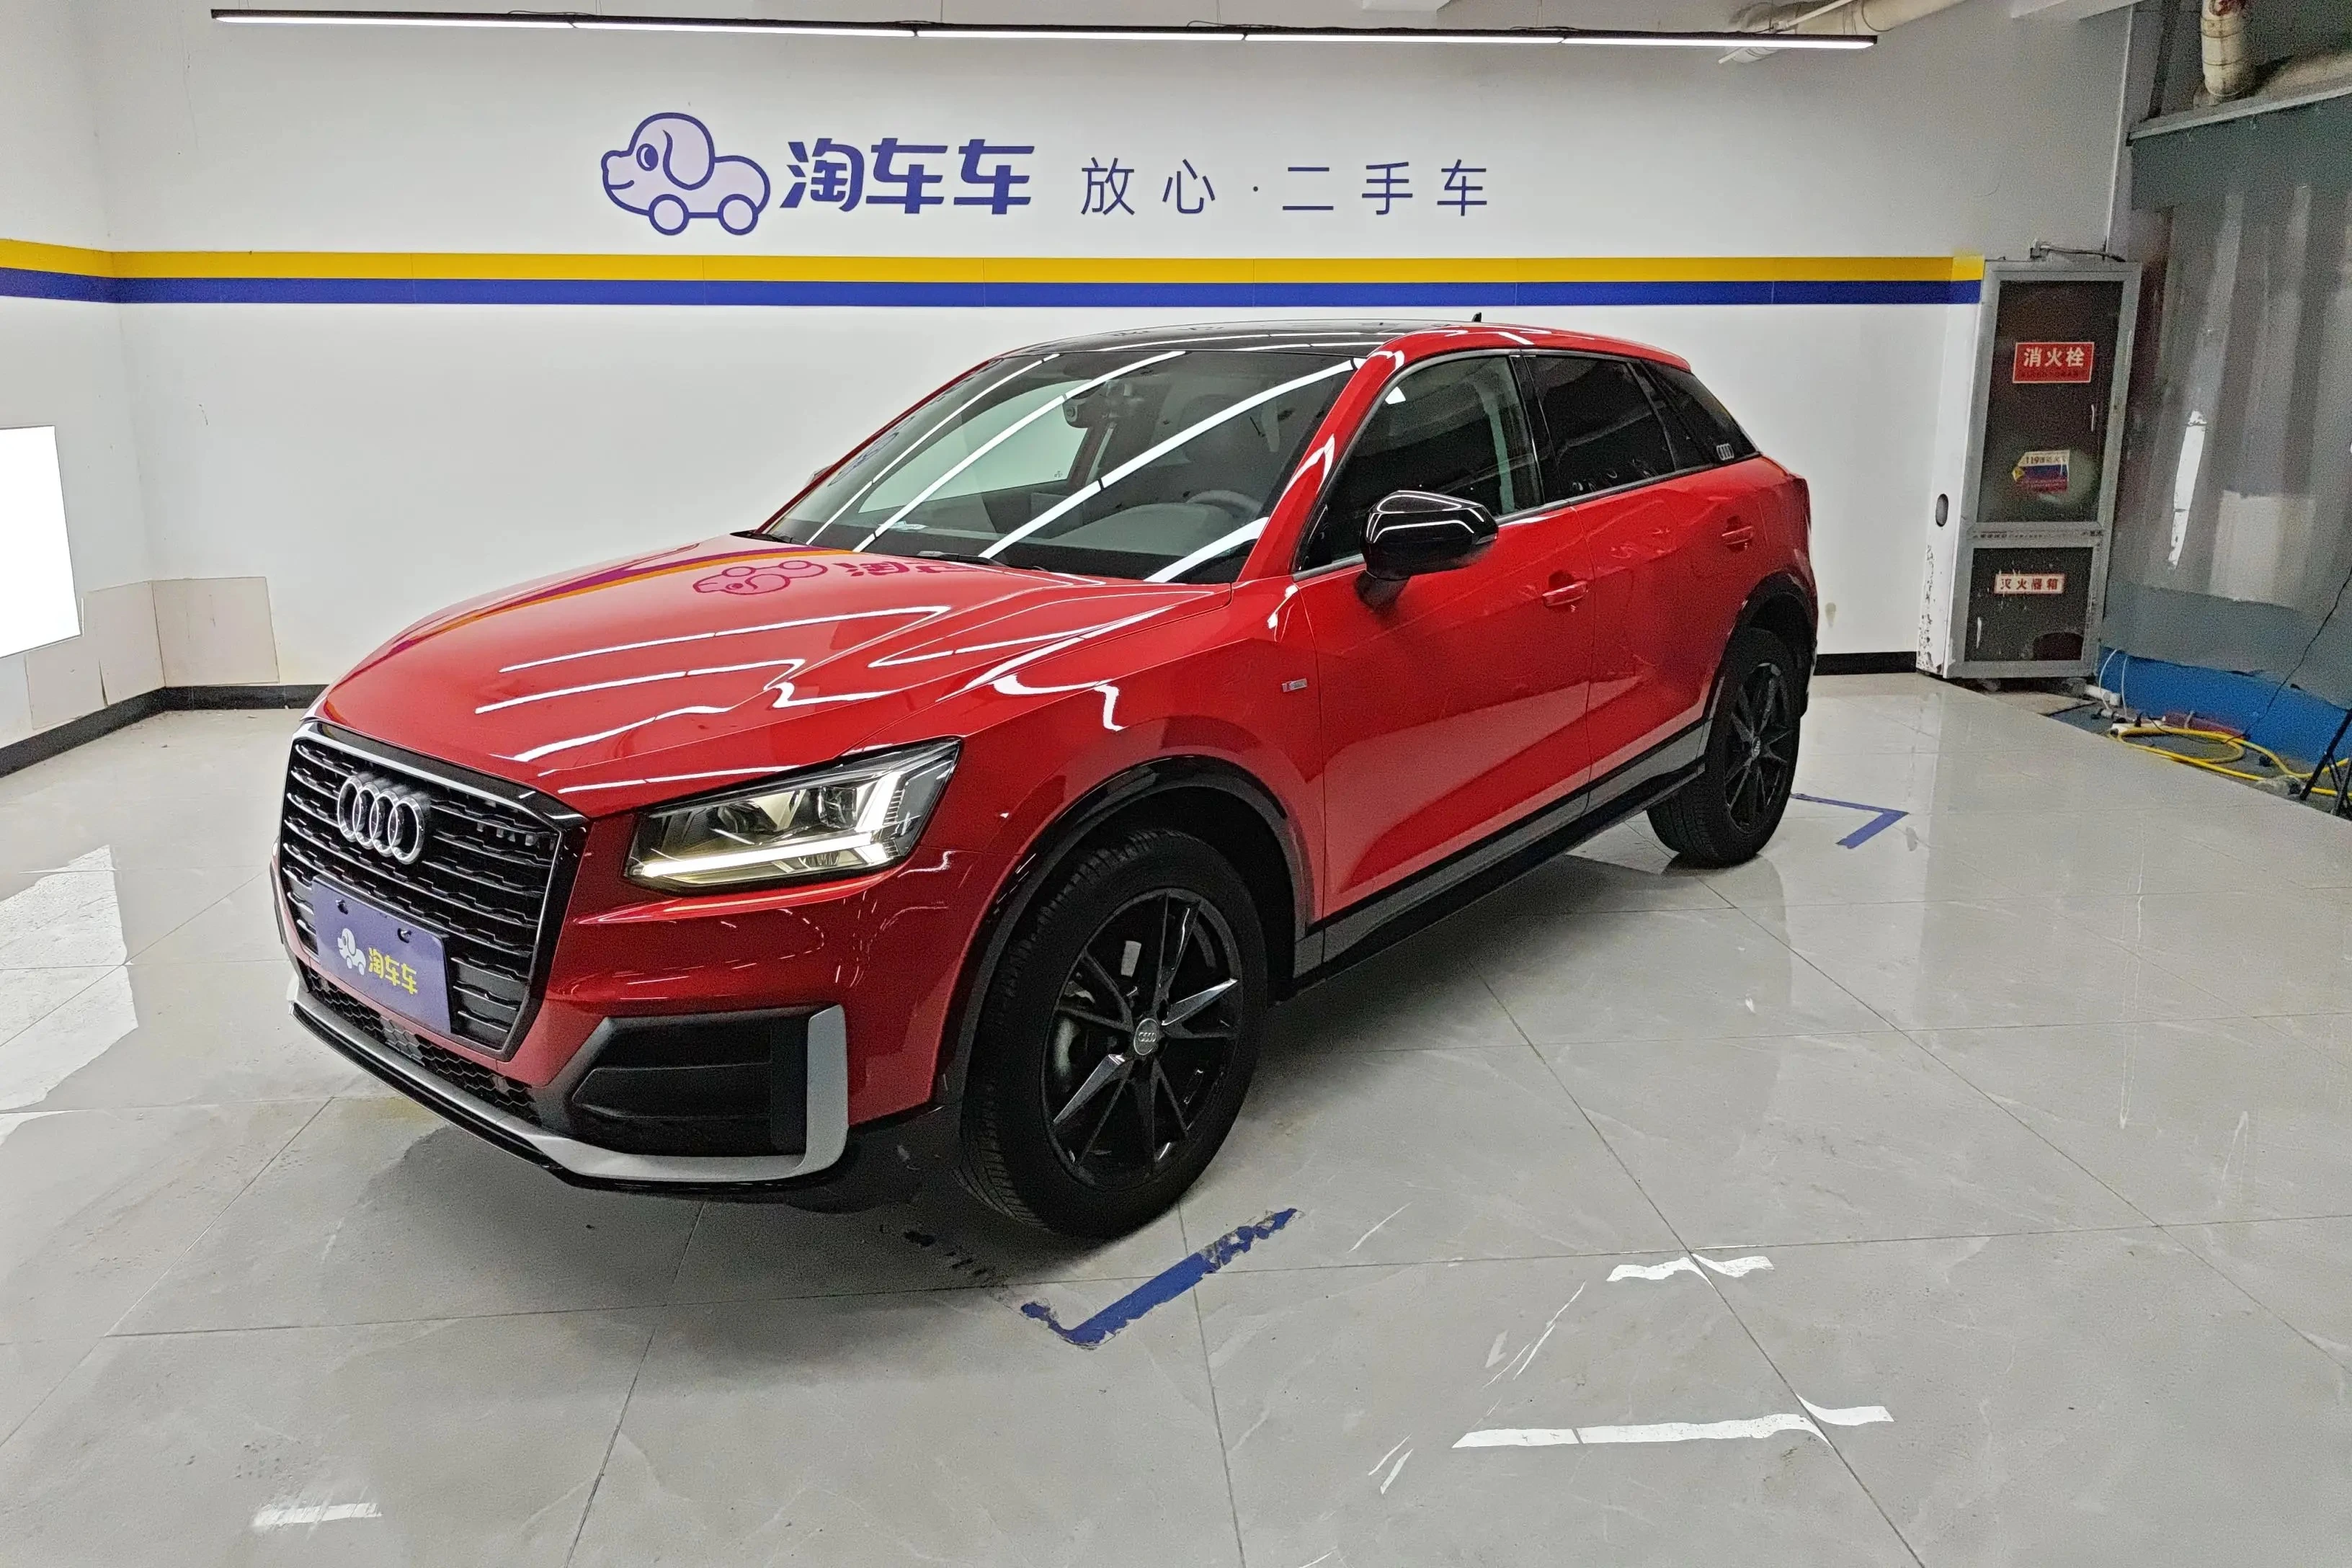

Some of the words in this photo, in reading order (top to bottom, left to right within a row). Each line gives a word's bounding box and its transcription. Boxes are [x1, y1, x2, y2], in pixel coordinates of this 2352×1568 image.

[780, 138, 1035, 215] 淘车车
[2023, 347, 2085, 368] 消火栓
[2000, 578, 2059, 590] 灭火器箱
[368, 947, 418, 995] 淘车车
